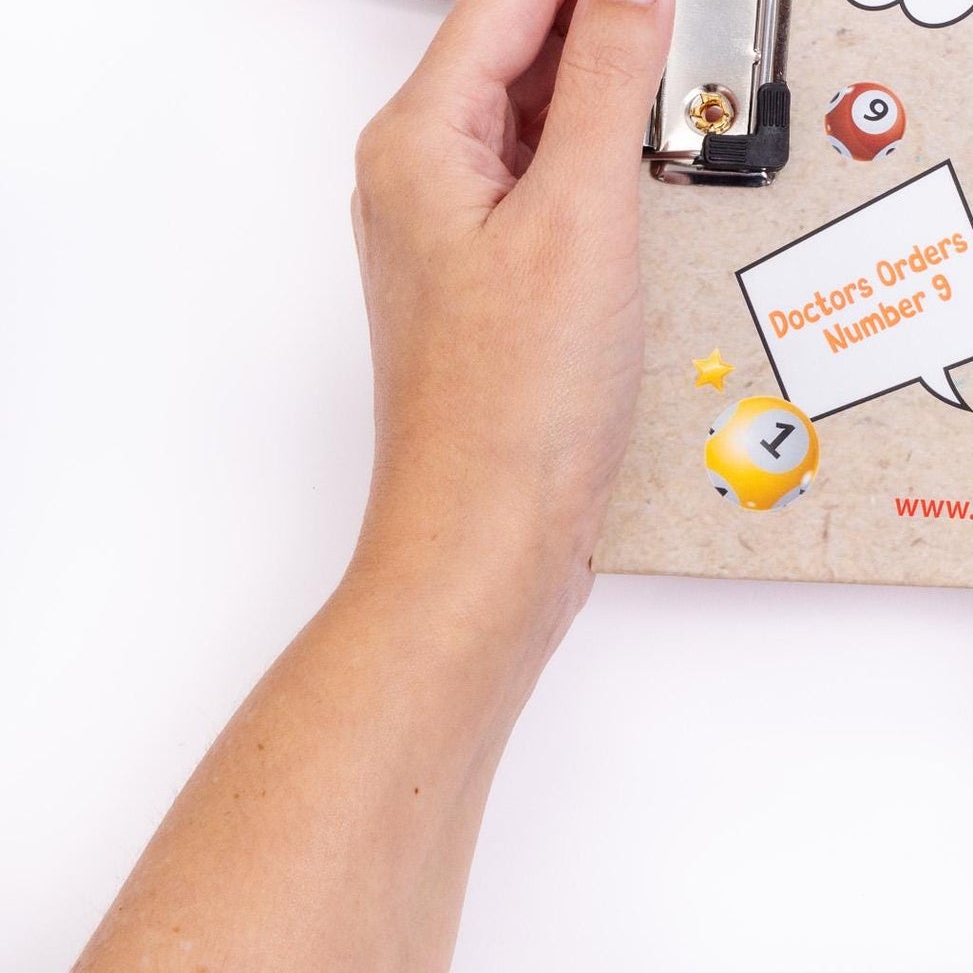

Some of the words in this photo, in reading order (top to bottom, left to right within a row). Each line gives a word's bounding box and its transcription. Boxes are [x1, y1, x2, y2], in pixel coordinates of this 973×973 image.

[862, 98, 890, 122] 9
[768, 277, 874, 339] Doctors
[876, 232, 969, 287] Orders
[822, 291, 926, 353] Number
[931, 273, 952, 302] 9
[759, 421, 797, 460] 1
